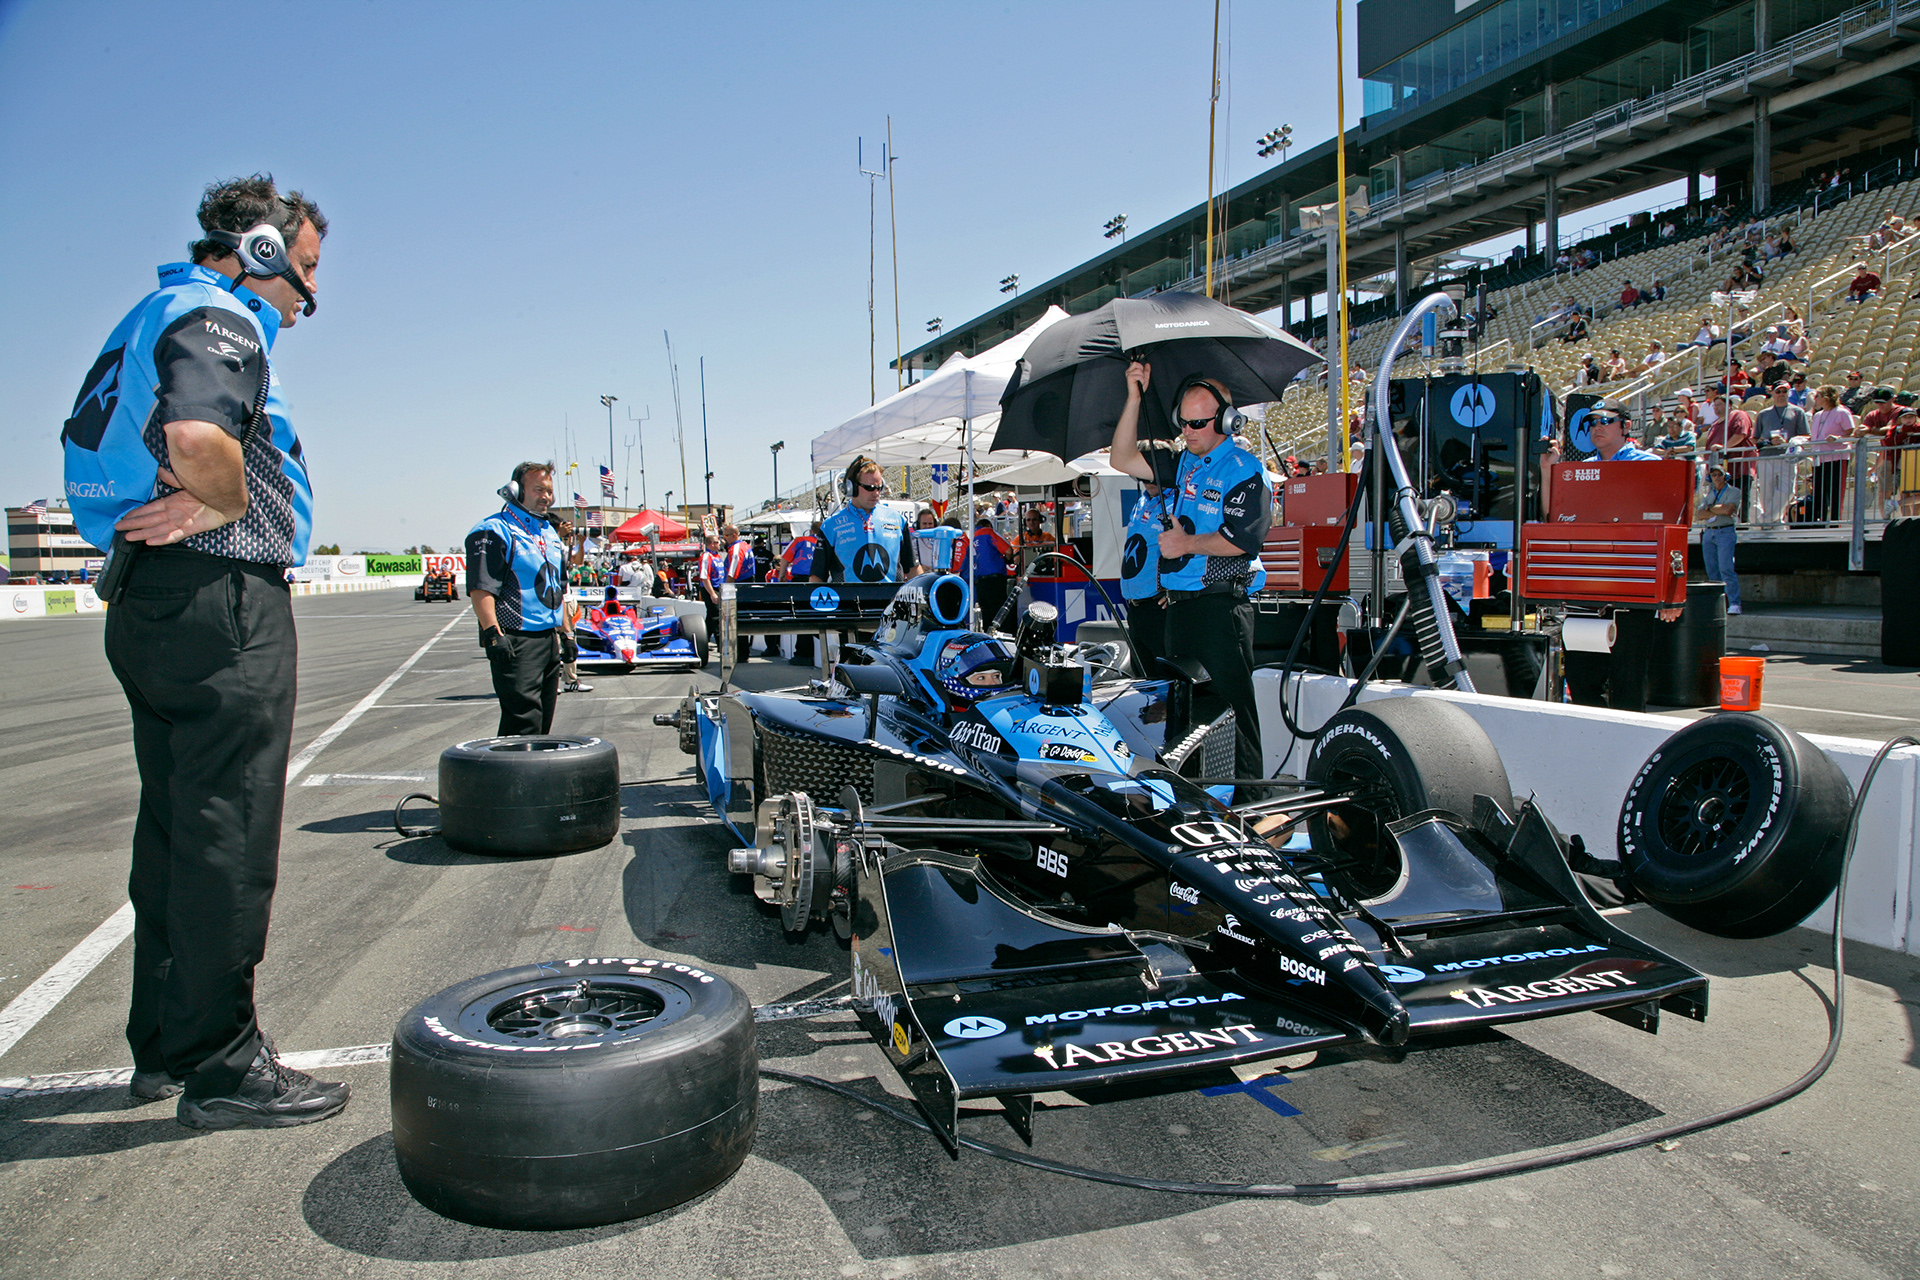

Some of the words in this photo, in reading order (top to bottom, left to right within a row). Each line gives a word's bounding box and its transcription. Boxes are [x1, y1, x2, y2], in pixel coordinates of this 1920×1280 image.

[209, 323, 261, 354] ARGENT
[1155, 320, 1210, 329] MOTODANICA
[1197, 503, 1220, 515] meijer
[1557, 513, 1577, 522] Front
[367, 558, 422, 573] Kawasaki
[1013, 720, 1087, 739] ARGENT
[1162, 724, 1210, 762] Firestone
[1315, 724, 1392, 760] FIREHAWK
[1050, 745, 1059, 757] Go
[1060, 745, 1088, 763] Daddy
[1623, 753, 1662, 854] Firestone
[1733, 744, 1783, 866] FIREHAWK
[1037, 845, 1069, 878] BBS
[565, 958, 715, 984] Firestone
[1280, 955, 1326, 986] BOSCH
[1433, 944, 1608, 973] MOTOROLA
[1472, 970, 1638, 1009] ARGENT
[1025, 992, 1246, 1026] MOTOROLA
[1063, 1024, 1263, 1068] ARGENT
